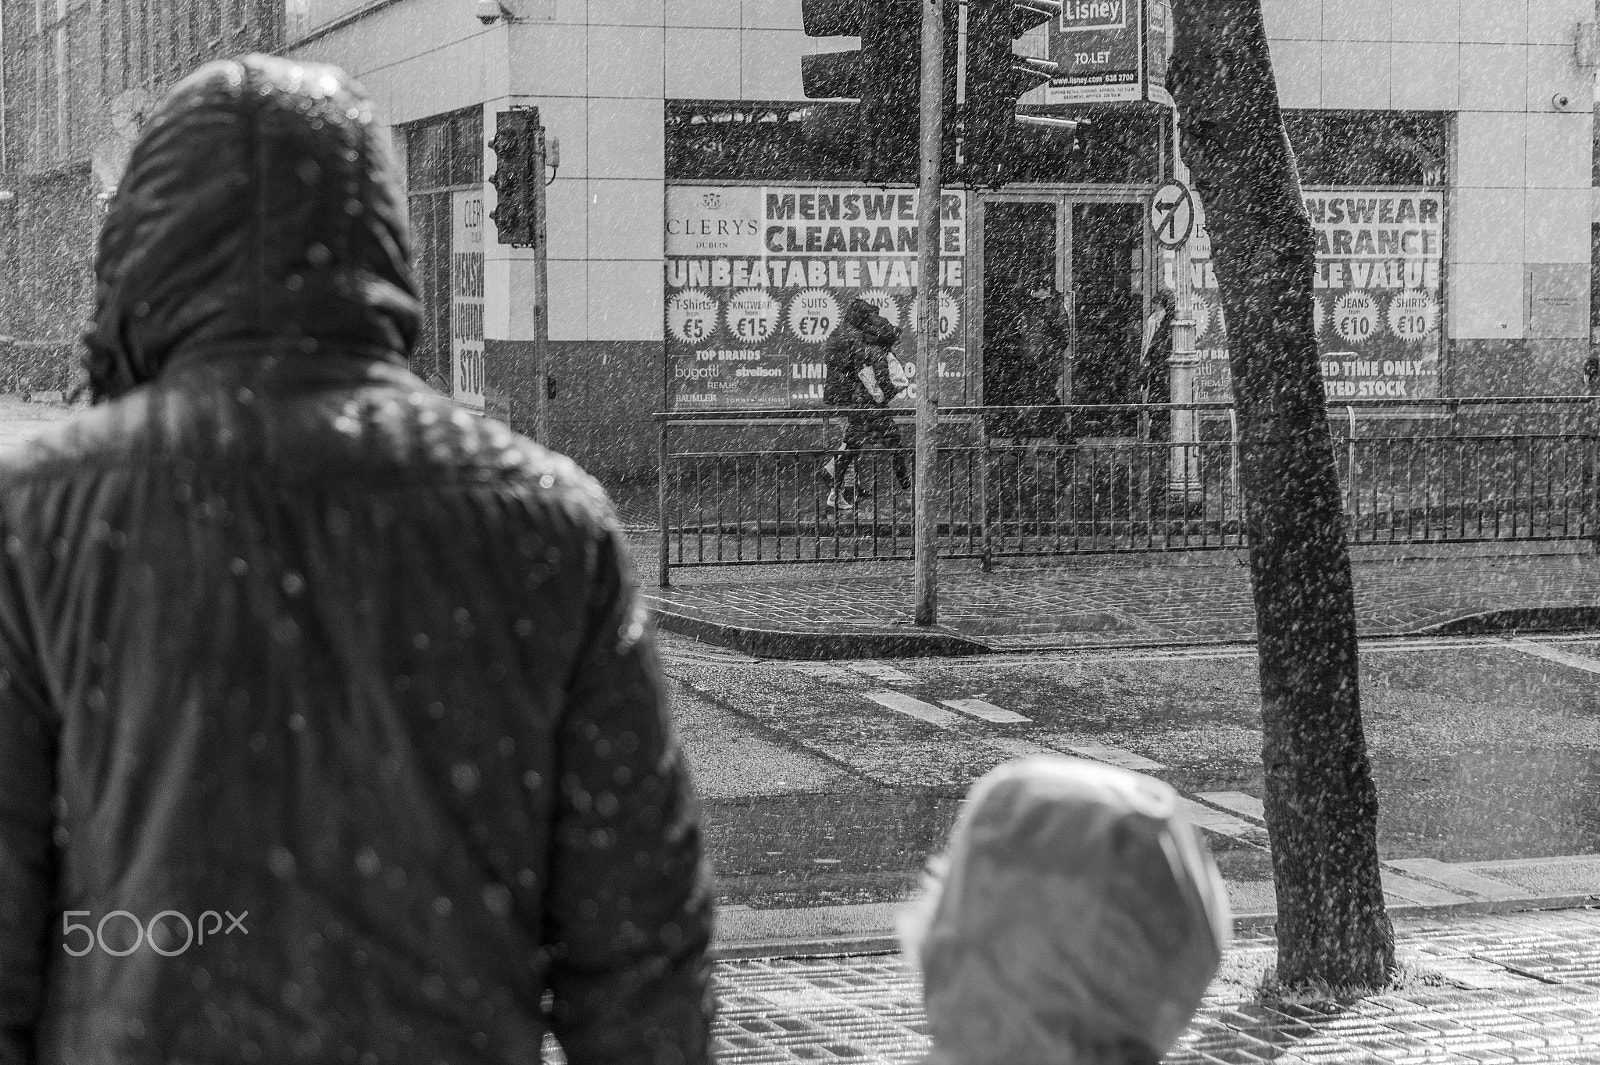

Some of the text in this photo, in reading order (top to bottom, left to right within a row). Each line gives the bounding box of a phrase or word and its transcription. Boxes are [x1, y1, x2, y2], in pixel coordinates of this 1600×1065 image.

[1066, 0, 1121, 21] Lisney
[1074, 51, 1110, 64] TO LET
[766, 193, 962, 220] MENSWER
[1304, 199, 1439, 223] NSWEAR
[666, 219, 758, 235] CLERYS
[765, 226, 960, 252] CLEARANE
[1314, 229, 1437, 254] ARANCE
[667, 259, 861, 288] UNBEATABLE
[1349, 262, 1440, 288] VALUE
[676, 299, 711, 310] T-Shirts
[801, 298, 828, 309] SUITS
[1341, 298, 1370, 309] JEANS
[1396, 298, 1427, 308] SHIRTS
[683, 318, 703, 338] €5
[737, 318, 768, 336] €15
[799, 316, 830, 335] €79
[1340, 316, 1370, 335] €10
[1397, 315, 1426, 334] €10
[696, 349, 761, 361] TOP BRANDS
[675, 364, 782, 379] bugatti strellson
[1342, 360, 1379, 376] TIME
[1383, 360, 1437, 376] ONLY...
[1358, 380, 1407, 396] STOCK
